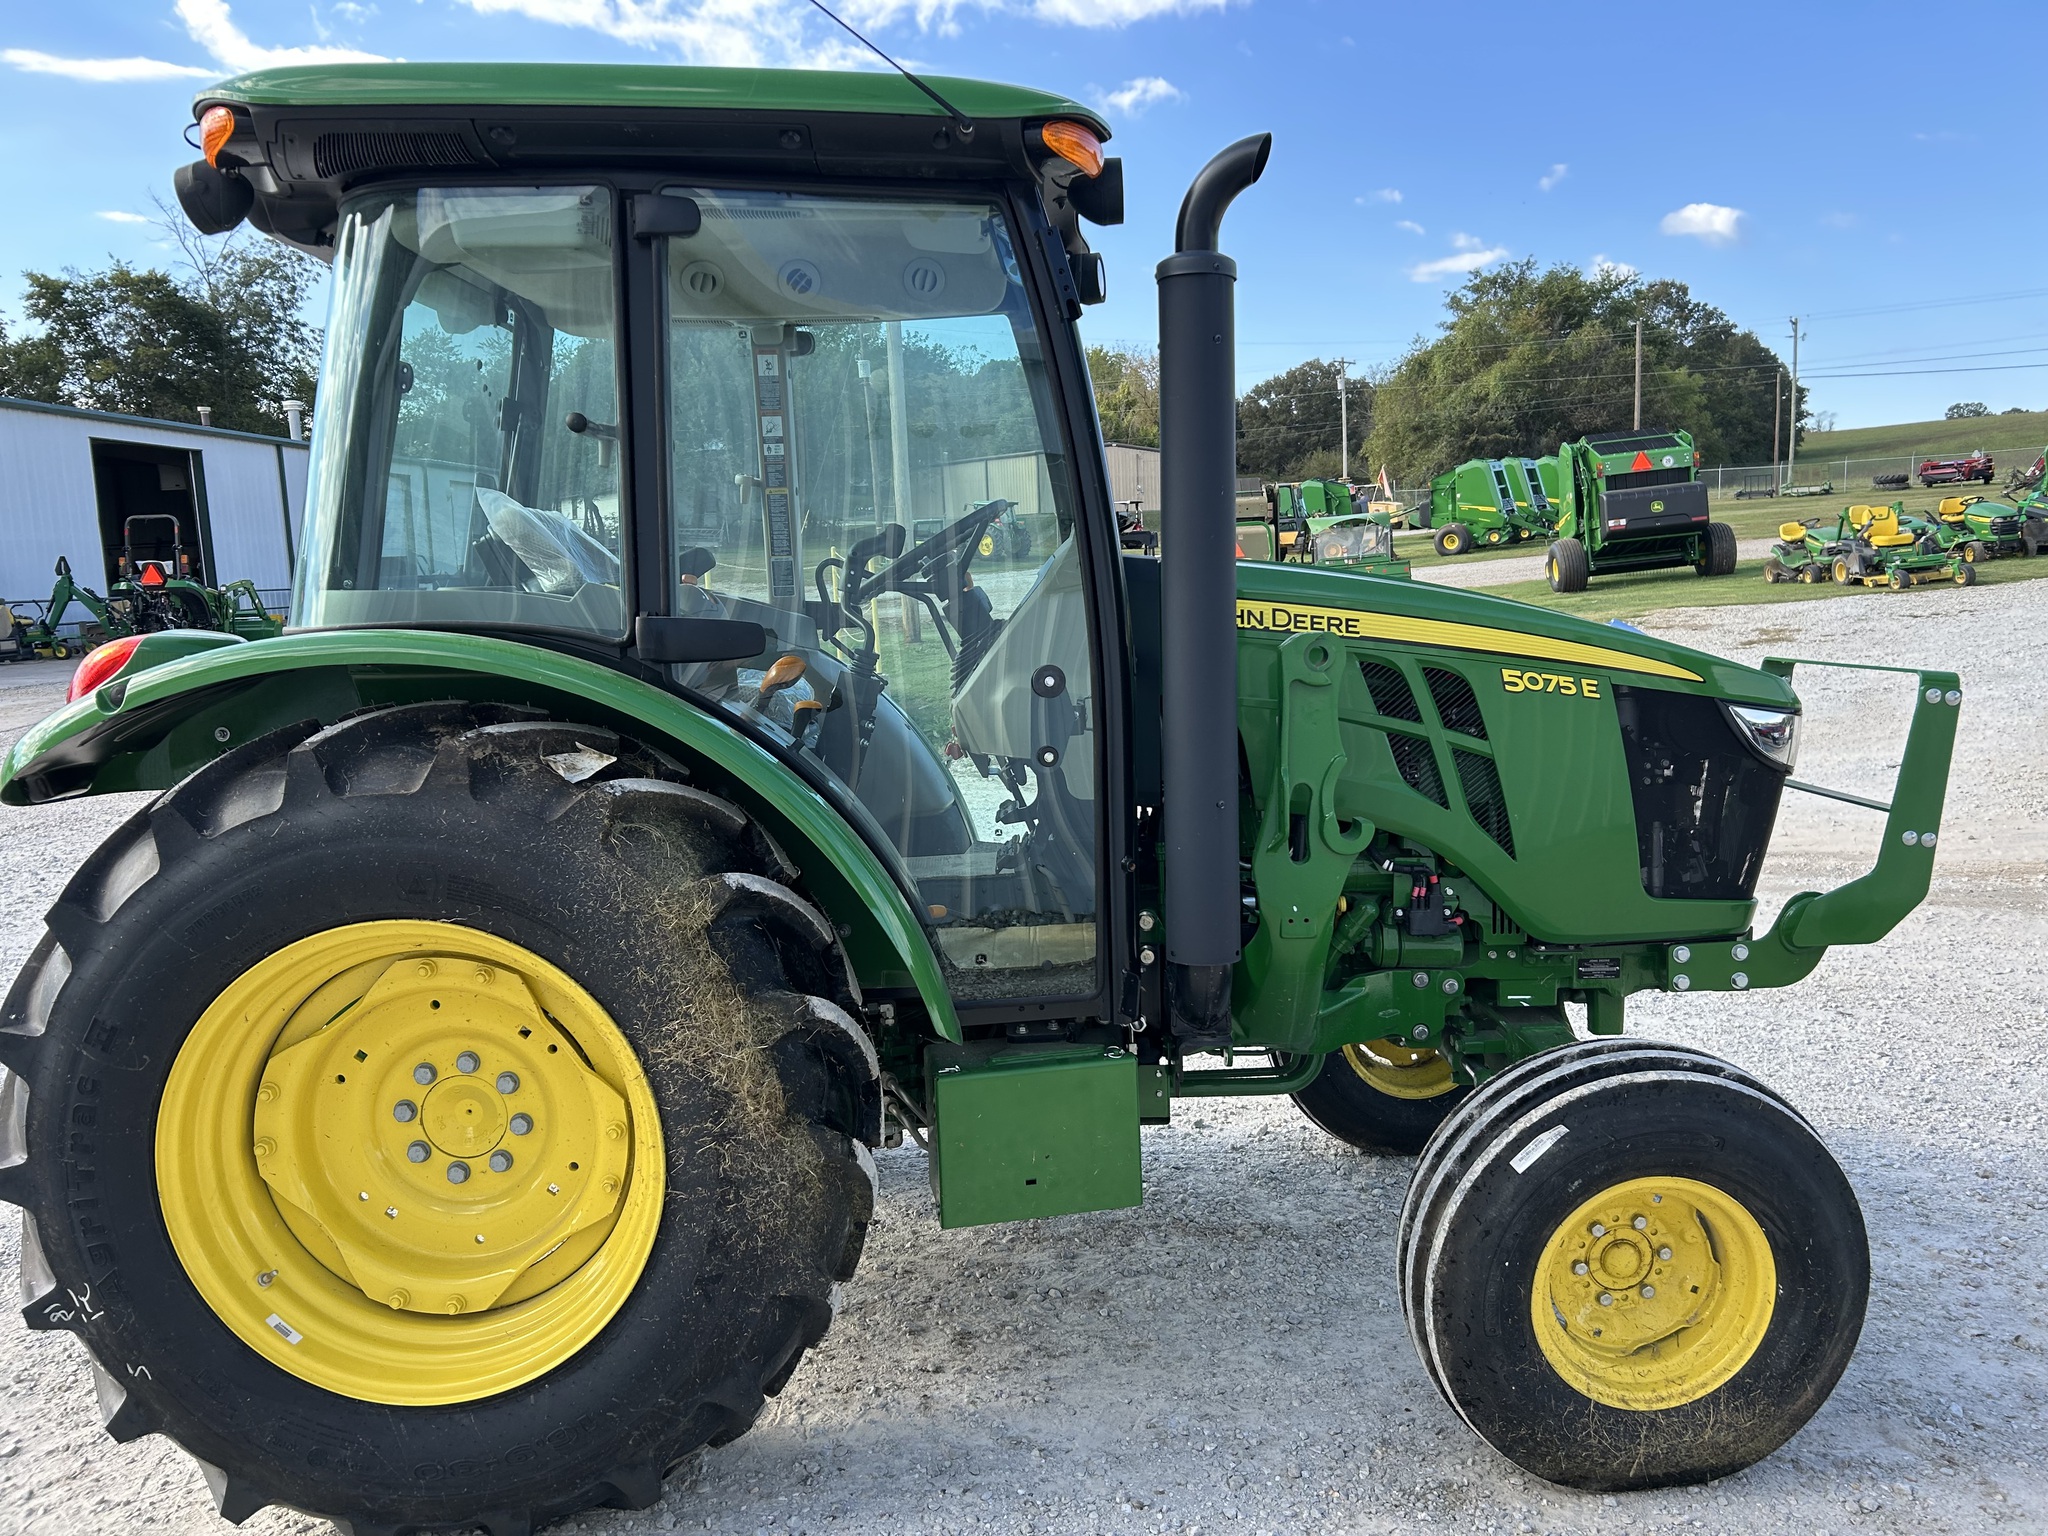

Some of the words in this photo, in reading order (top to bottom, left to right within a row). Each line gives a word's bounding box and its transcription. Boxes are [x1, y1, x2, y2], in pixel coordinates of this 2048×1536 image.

[1271, 607, 1360, 635] DEERE
[1501, 668, 1577, 695] 5075
[1580, 678, 1601, 698] E
